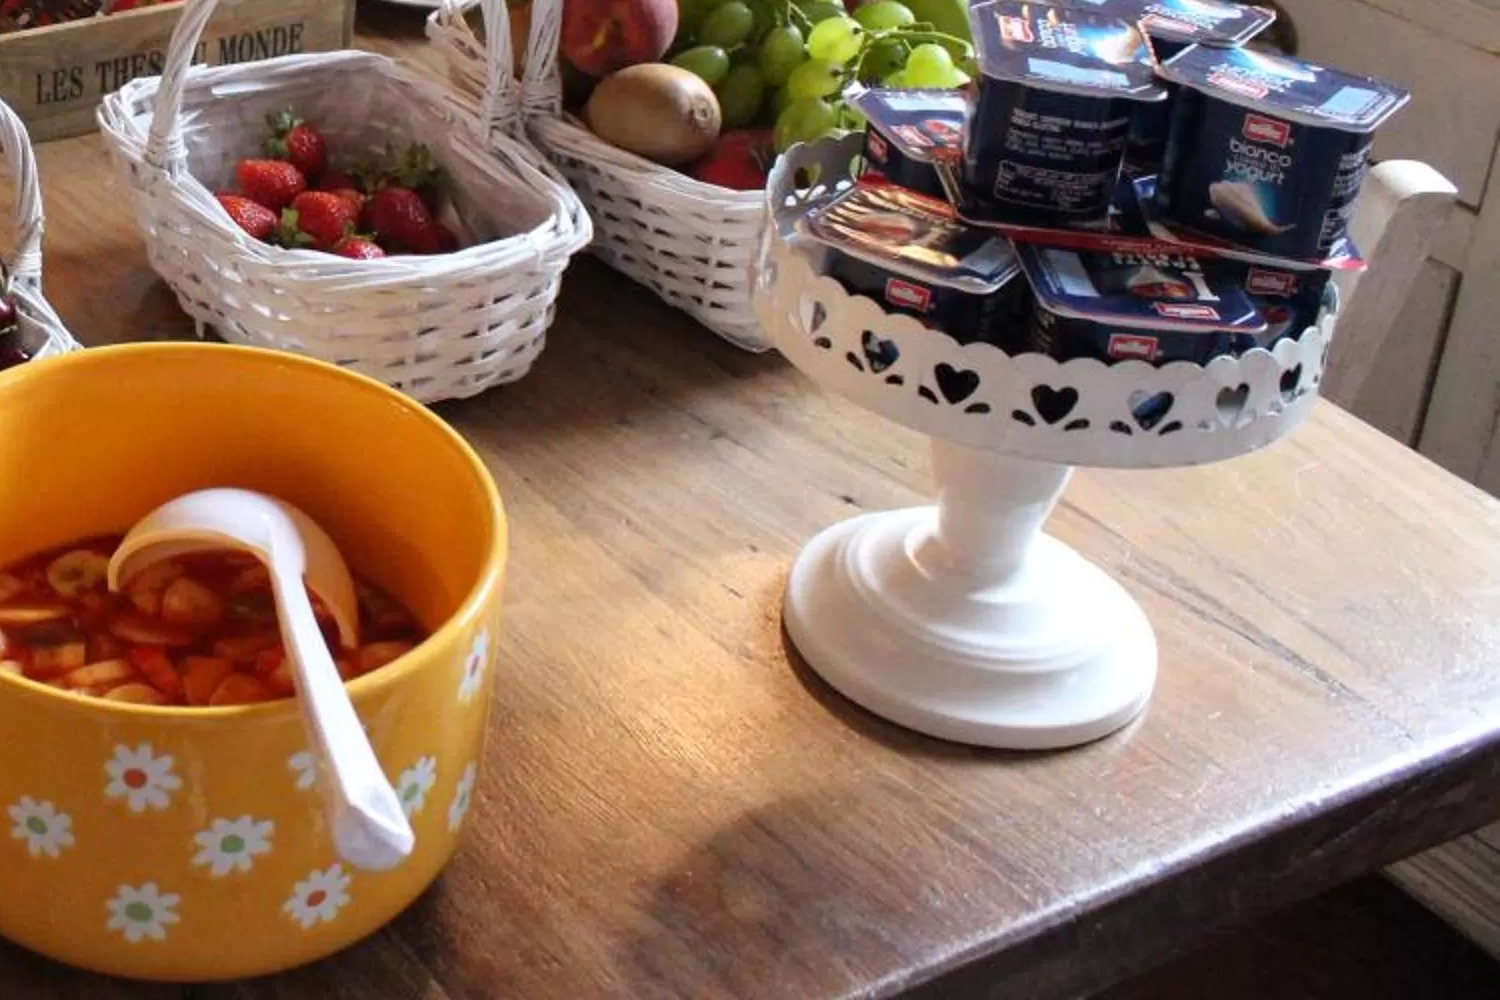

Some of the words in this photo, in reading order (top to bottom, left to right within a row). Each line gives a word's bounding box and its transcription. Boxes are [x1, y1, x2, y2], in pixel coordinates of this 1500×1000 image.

[35, 66, 84, 105] LES
[96, 50, 166, 93] THES
[217, 22, 304, 66] MONDE
